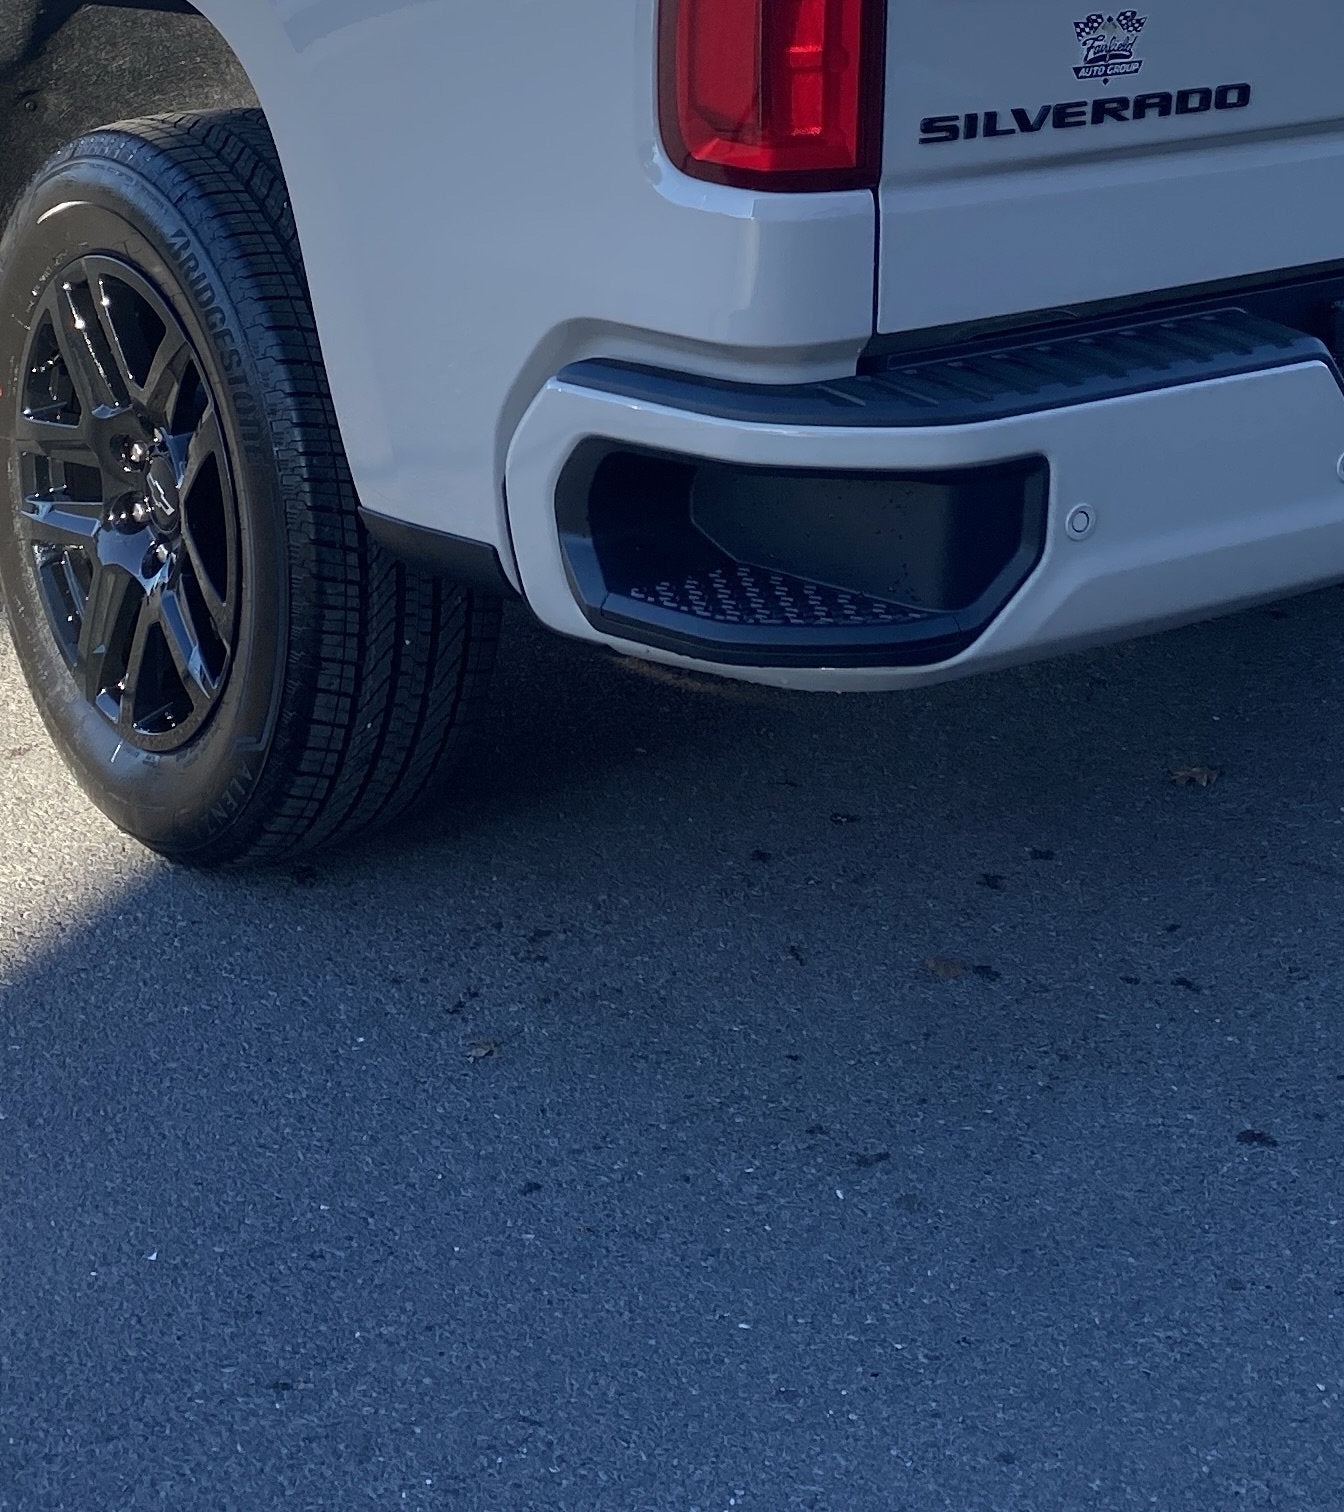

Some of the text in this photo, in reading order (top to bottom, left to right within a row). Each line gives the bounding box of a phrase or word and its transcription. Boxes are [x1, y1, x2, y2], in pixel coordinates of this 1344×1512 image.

[1082, 34, 1138, 63] Fairfield
[1078, 62, 1140, 78] AUTO GROUP
[919, 82, 1252, 145] SILVERADO
